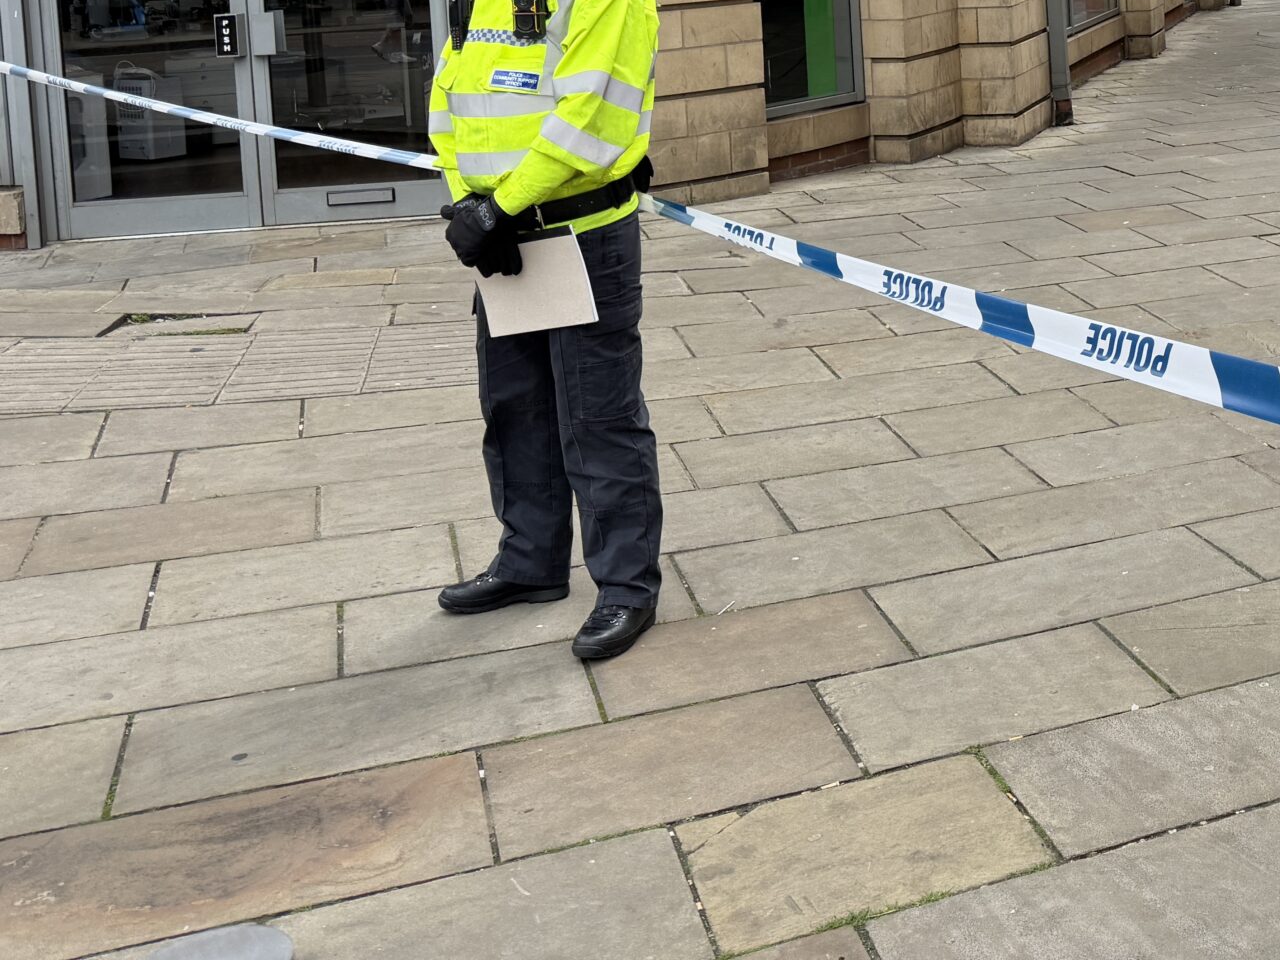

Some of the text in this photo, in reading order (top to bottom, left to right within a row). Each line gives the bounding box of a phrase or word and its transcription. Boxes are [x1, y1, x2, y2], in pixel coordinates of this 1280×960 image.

[222, 19, 231, 52] PUSH
[879, 269, 947, 312] POLICE
[1080, 323, 1173, 378] POLICE
